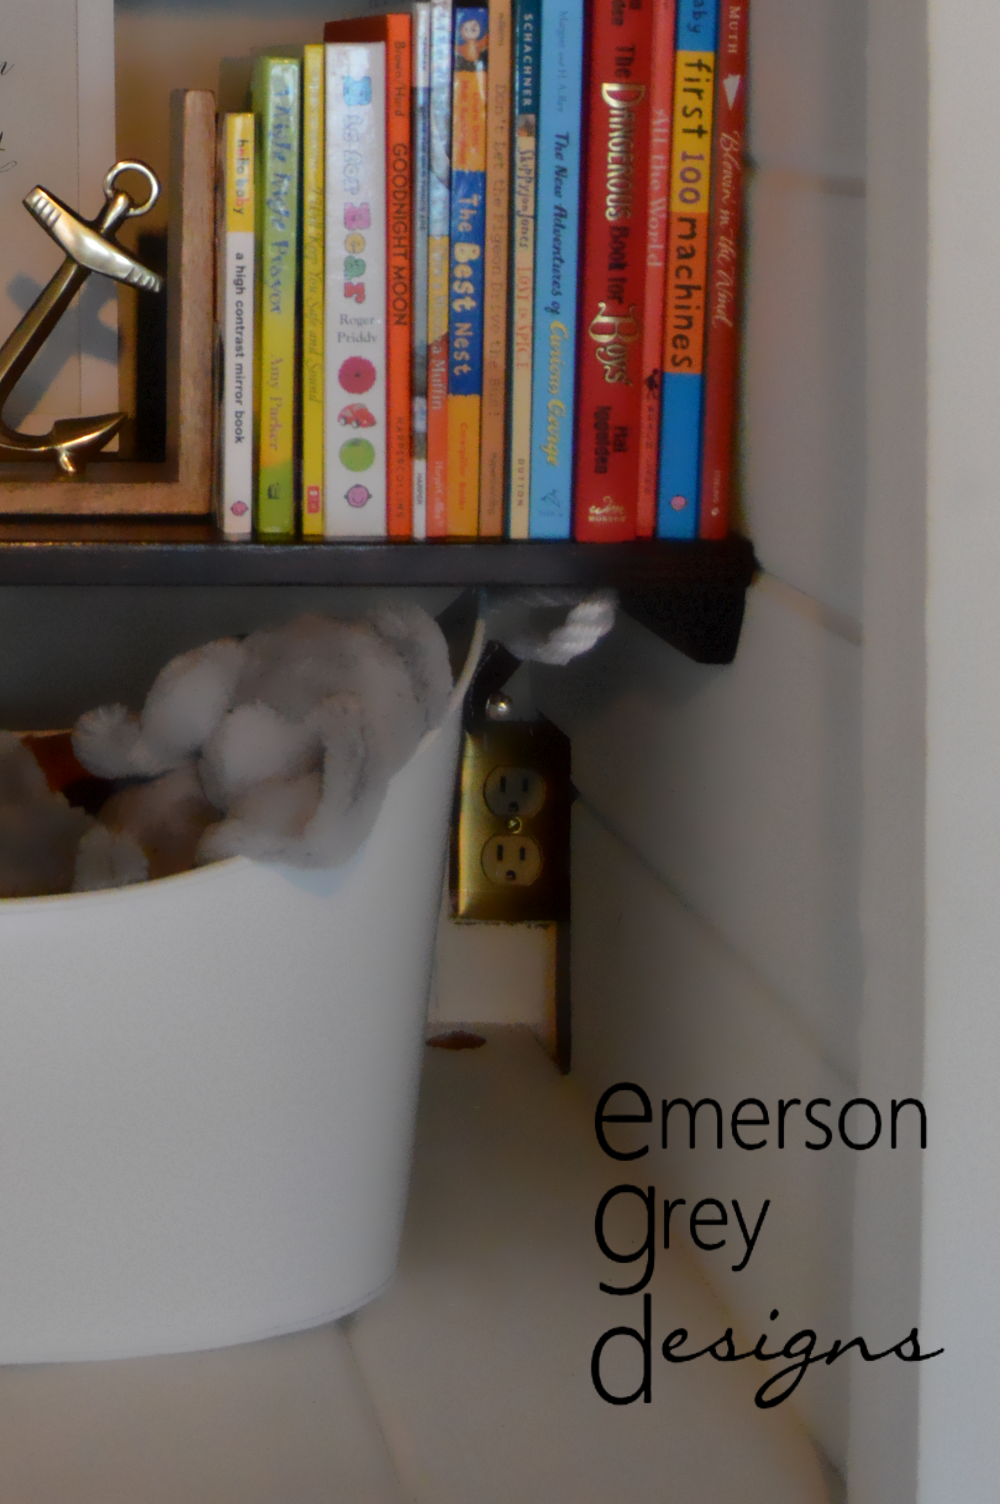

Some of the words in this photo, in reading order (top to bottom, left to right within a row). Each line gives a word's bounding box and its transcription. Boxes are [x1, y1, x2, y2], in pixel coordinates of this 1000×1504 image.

[727, 5, 742, 55] MUTH
[522, 13, 534, 107] SCHACHNER
[614, 43, 637, 79] The
[494, 83, 508, 135] Don't
[681, 58, 713, 140] first
[554, 131, 570, 161] The
[651, 108, 669, 143] All
[235, 138, 250, 174] hello
[493, 140, 507, 170] Let
[601, 82, 646, 222] DANGEROUS
[649, 153, 668, 191] the
[492, 179, 507, 208] the
[553, 165, 569, 198] New
[678, 150, 705, 205] 100
[391, 143, 408, 260] GOODNIGHT
[457, 193, 480, 233] The
[718, 207, 732, 228] in
[343, 201, 372, 304] Bear
[489, 213, 505, 275] Pigeon
[550, 204, 568, 297] Adventures
[607, 225, 631, 271] Book
[646, 196, 667, 267] World
[716, 228, 737, 266] the
[233, 265, 248, 295] high
[264, 240, 290, 316] Prayer
[391, 265, 407, 327] MOON
[451, 241, 482, 313] Best
[517, 265, 532, 302] LOST
[607, 277, 628, 305] for
[670, 217, 703, 369] machines
[711, 268, 735, 329] Wind
[234, 299, 248, 358] contrast
[303, 297, 322, 327] Safe
[339, 313, 376, 326] Roger
[490, 281, 503, 334] Drive
[543, 301, 561, 316] of
[307, 330, 322, 355] and
[337, 332, 379, 345] Priddy
[431, 345, 443, 354] a
[452, 322, 474, 376] Nest
[490, 339, 502, 369] the
[515, 319, 532, 370] SPICE
[547, 320, 569, 395] Curious
[588, 301, 640, 387] Boys
[234, 362, 247, 407] mirror
[266, 354, 284, 391] Amy
[305, 360, 322, 404] Sound
[430, 359, 447, 410] Muffin
[488, 377, 501, 416] Bus!
[234, 410, 247, 444] book
[269, 395, 284, 450] Parker
[540, 398, 567, 467] George
[612, 425, 629, 453] Hal
[416, 473, 425, 506] HARPER
[516, 458, 526, 507] DUTTON
